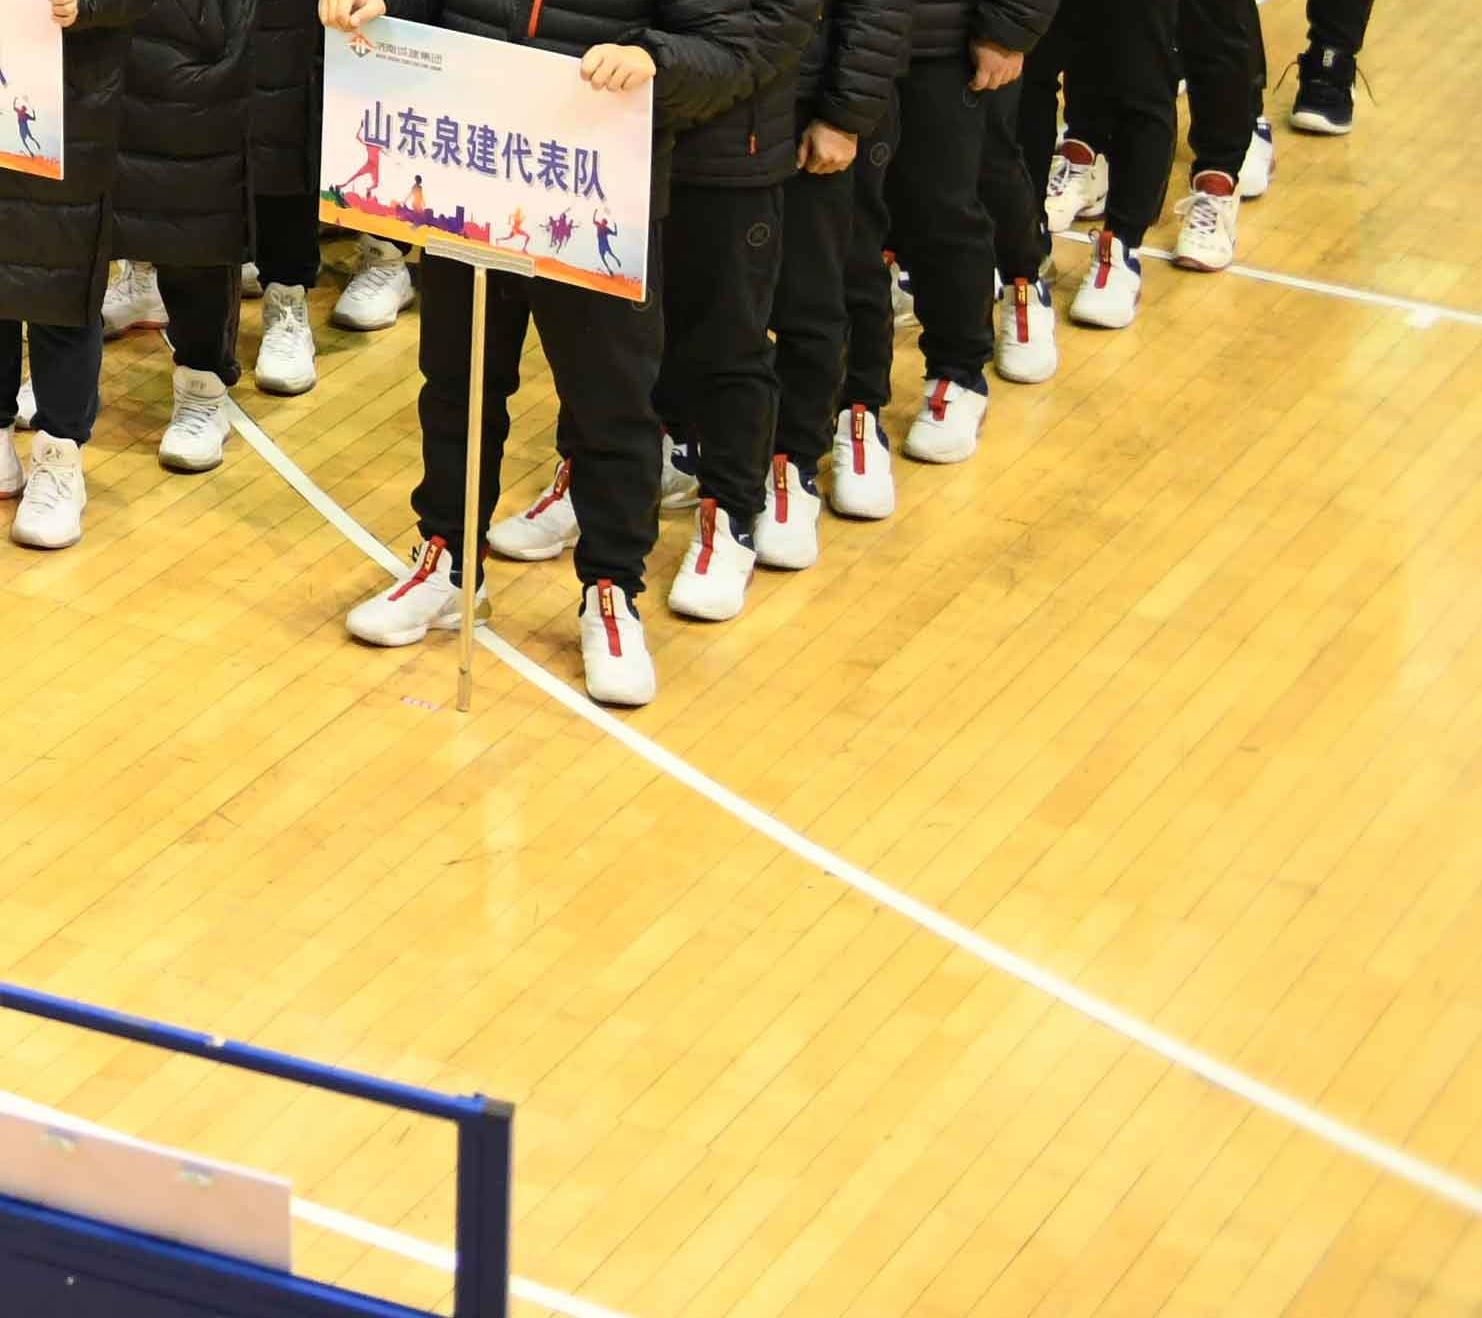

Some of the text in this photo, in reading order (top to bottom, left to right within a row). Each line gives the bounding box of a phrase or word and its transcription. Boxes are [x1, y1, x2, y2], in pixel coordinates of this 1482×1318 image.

[363, 101, 606, 201] 山东泉建代表队
